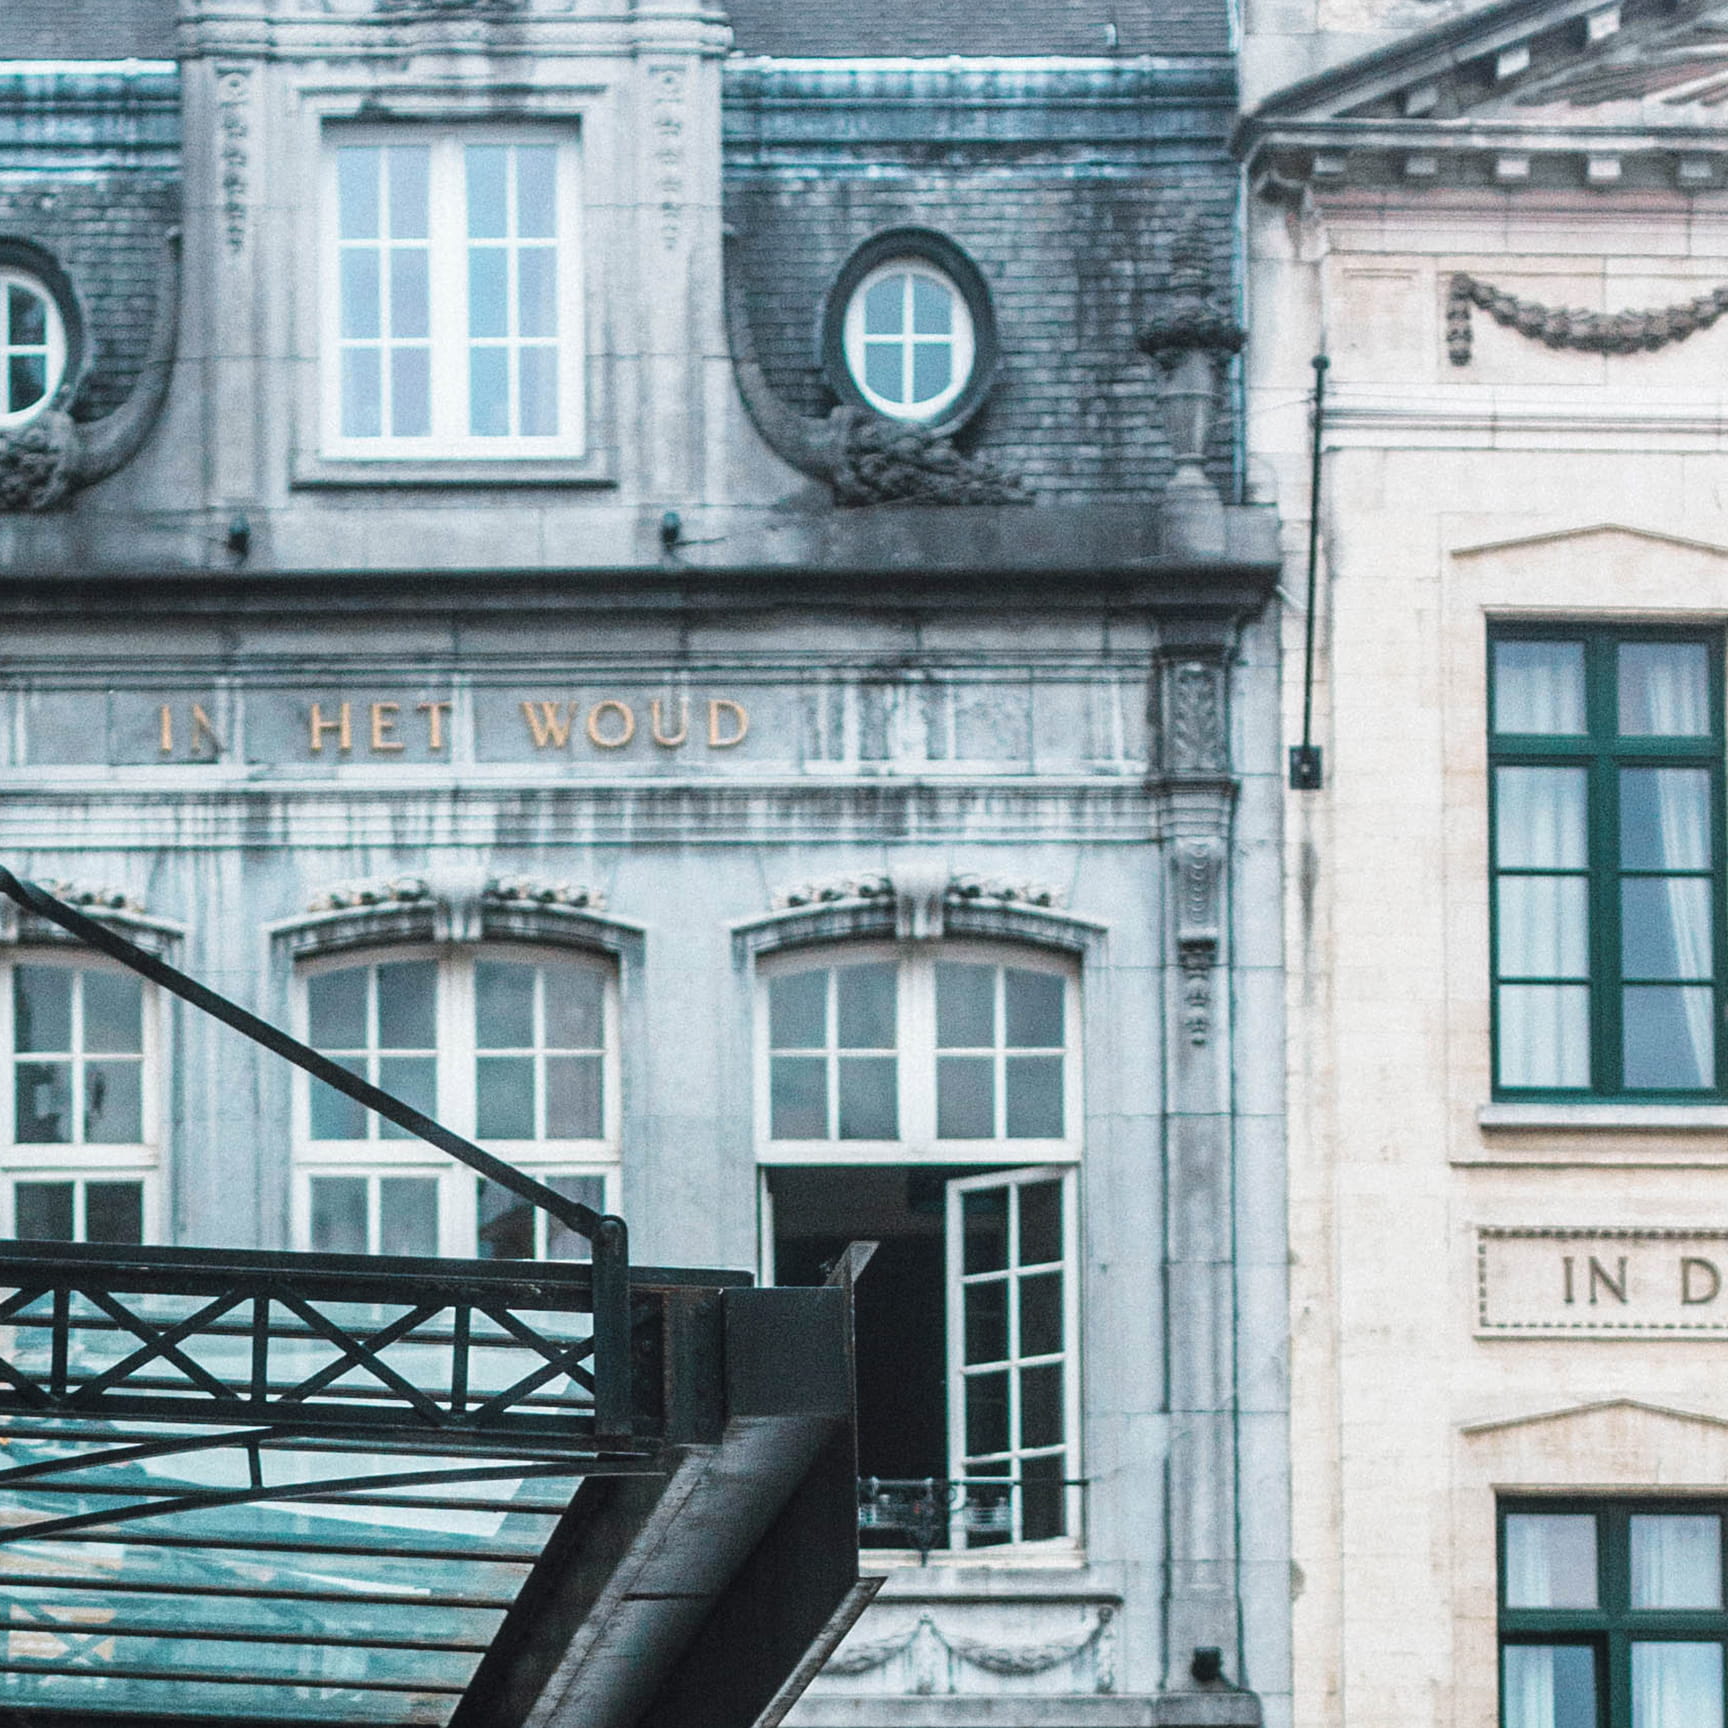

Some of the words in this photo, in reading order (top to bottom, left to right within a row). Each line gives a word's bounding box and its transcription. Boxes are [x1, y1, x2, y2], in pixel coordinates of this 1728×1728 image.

[159, 701, 229, 753] IN
[308, 700, 453, 752] HET
[520, 699, 751, 751] WOUD
[1560, 1255, 1630, 1306] IN
[1680, 1256, 1723, 1306] D
